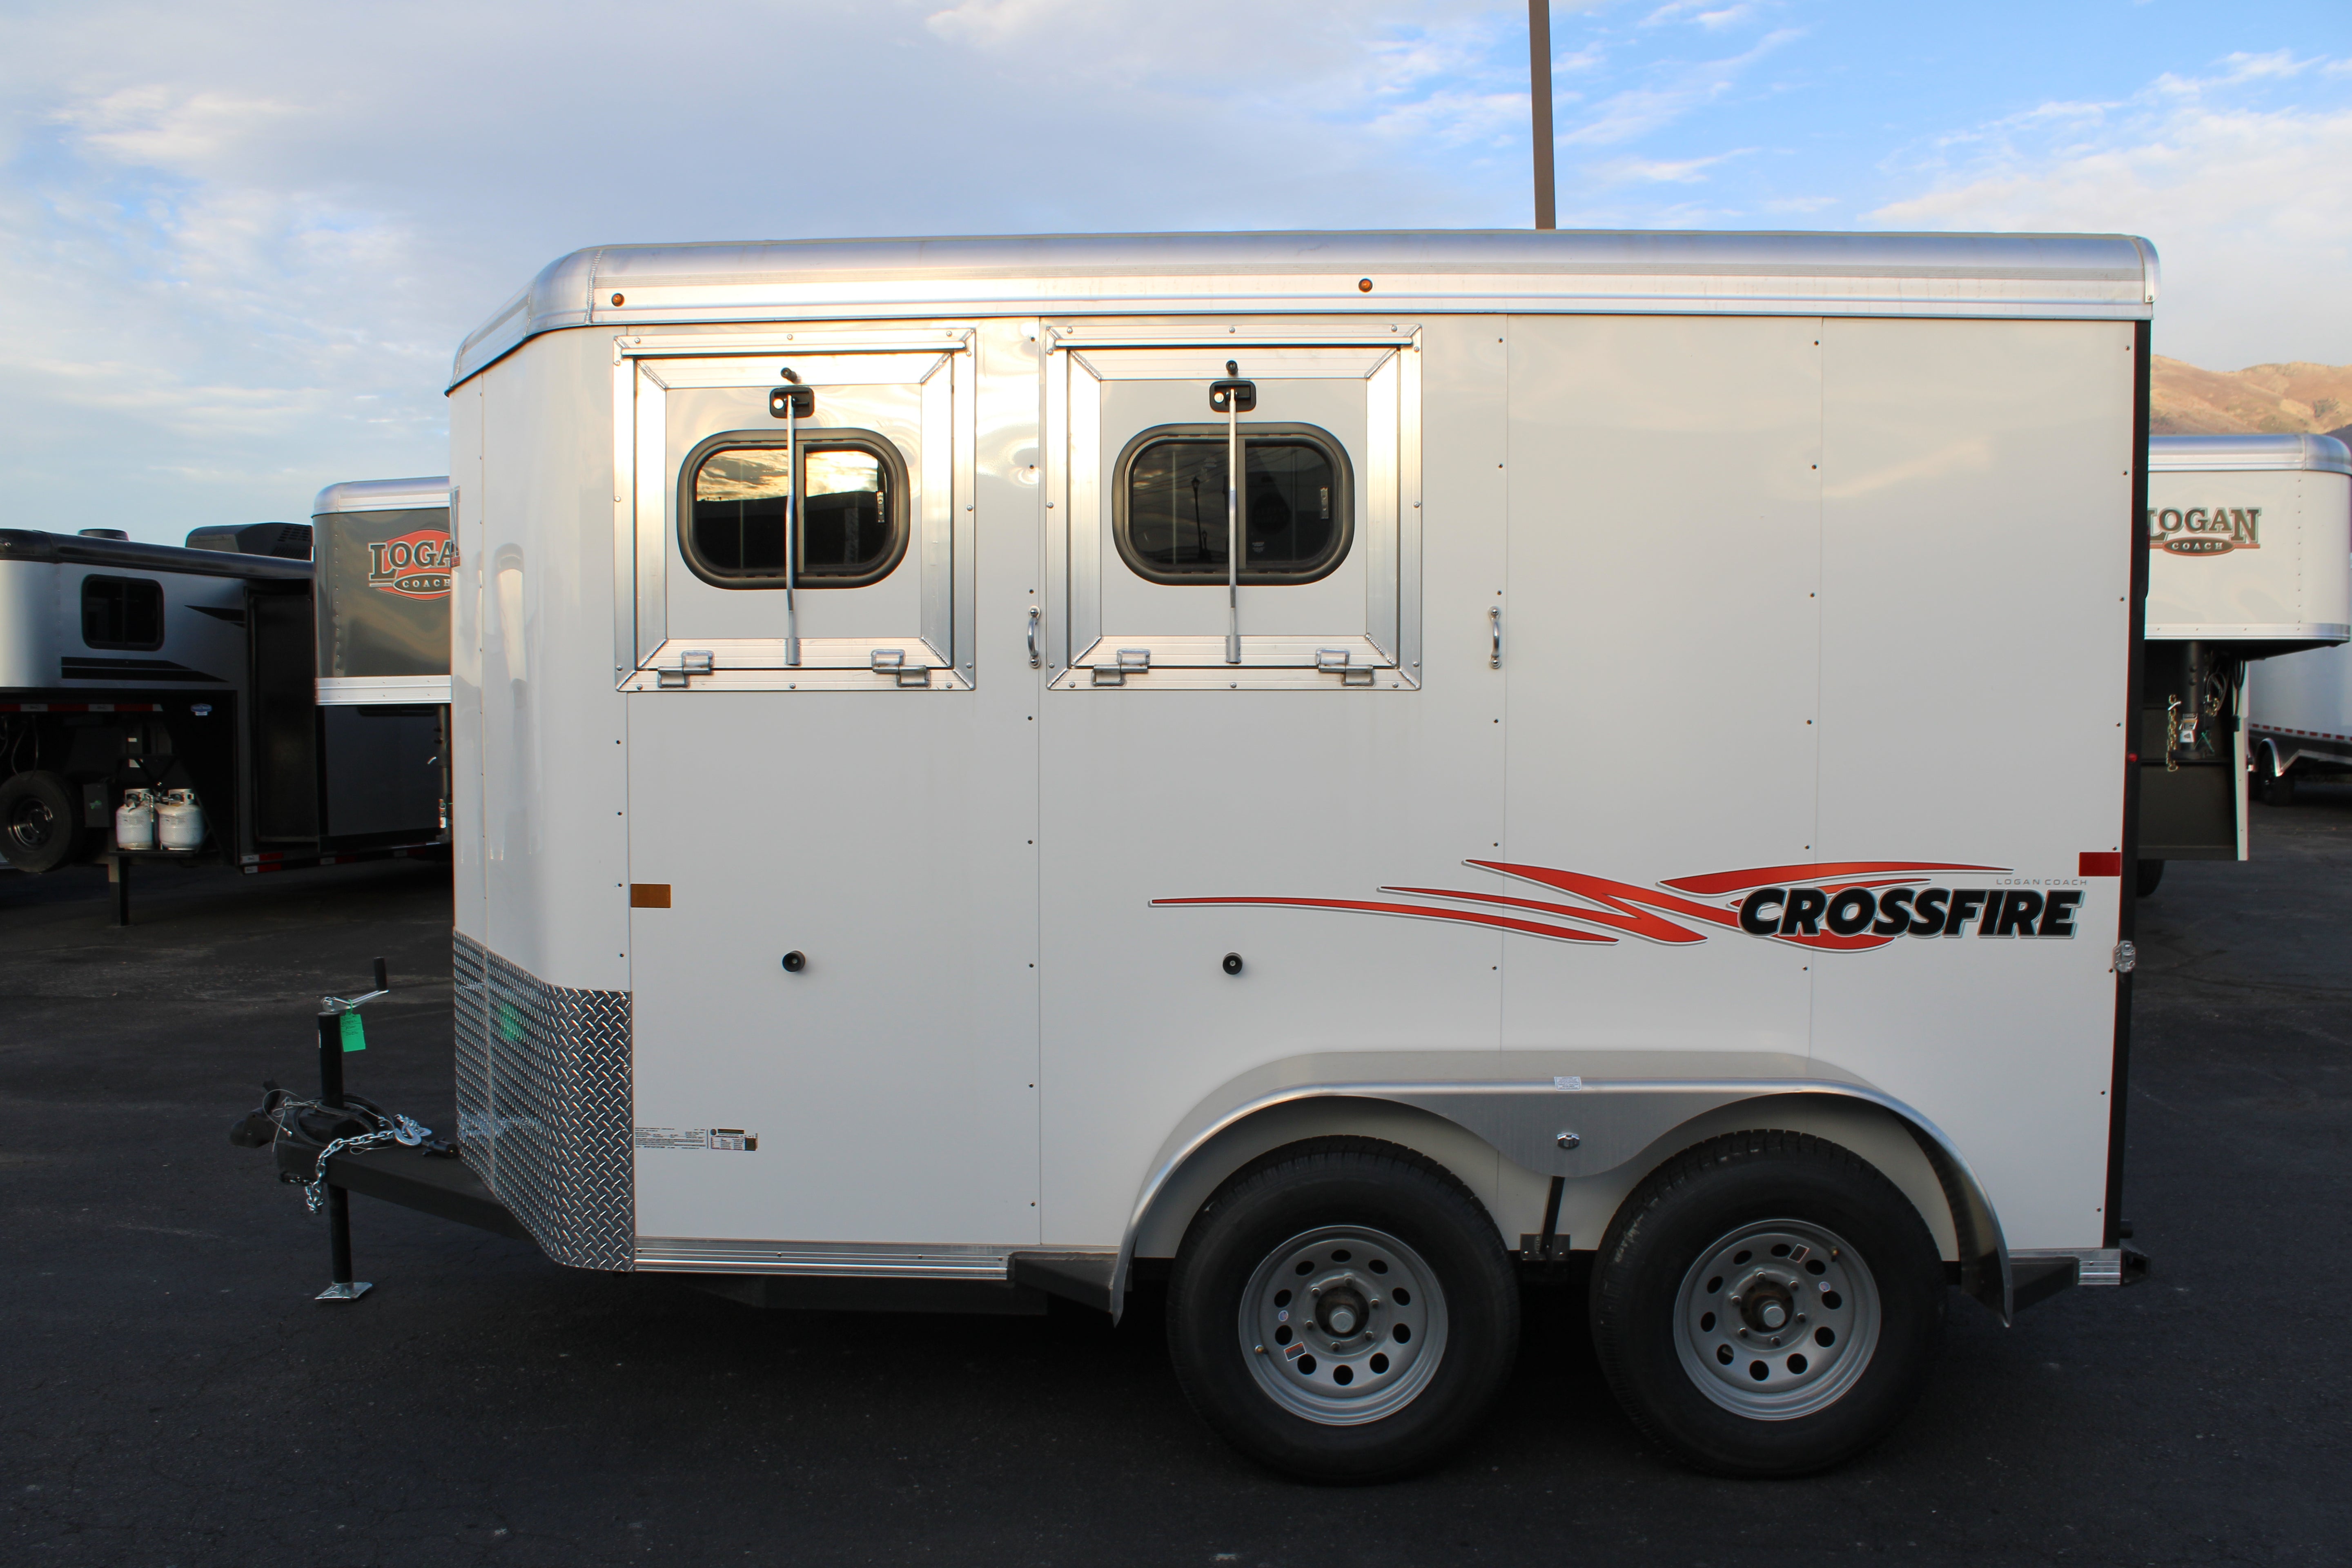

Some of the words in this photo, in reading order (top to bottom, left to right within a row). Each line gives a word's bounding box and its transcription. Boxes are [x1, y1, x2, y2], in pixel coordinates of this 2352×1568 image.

[2148, 508, 2261, 543] LOGAN
[369, 540, 450, 581] LOGA
[403, 579, 450, 587] COACH
[1738, 887, 2085, 938] CROSSFIRE
